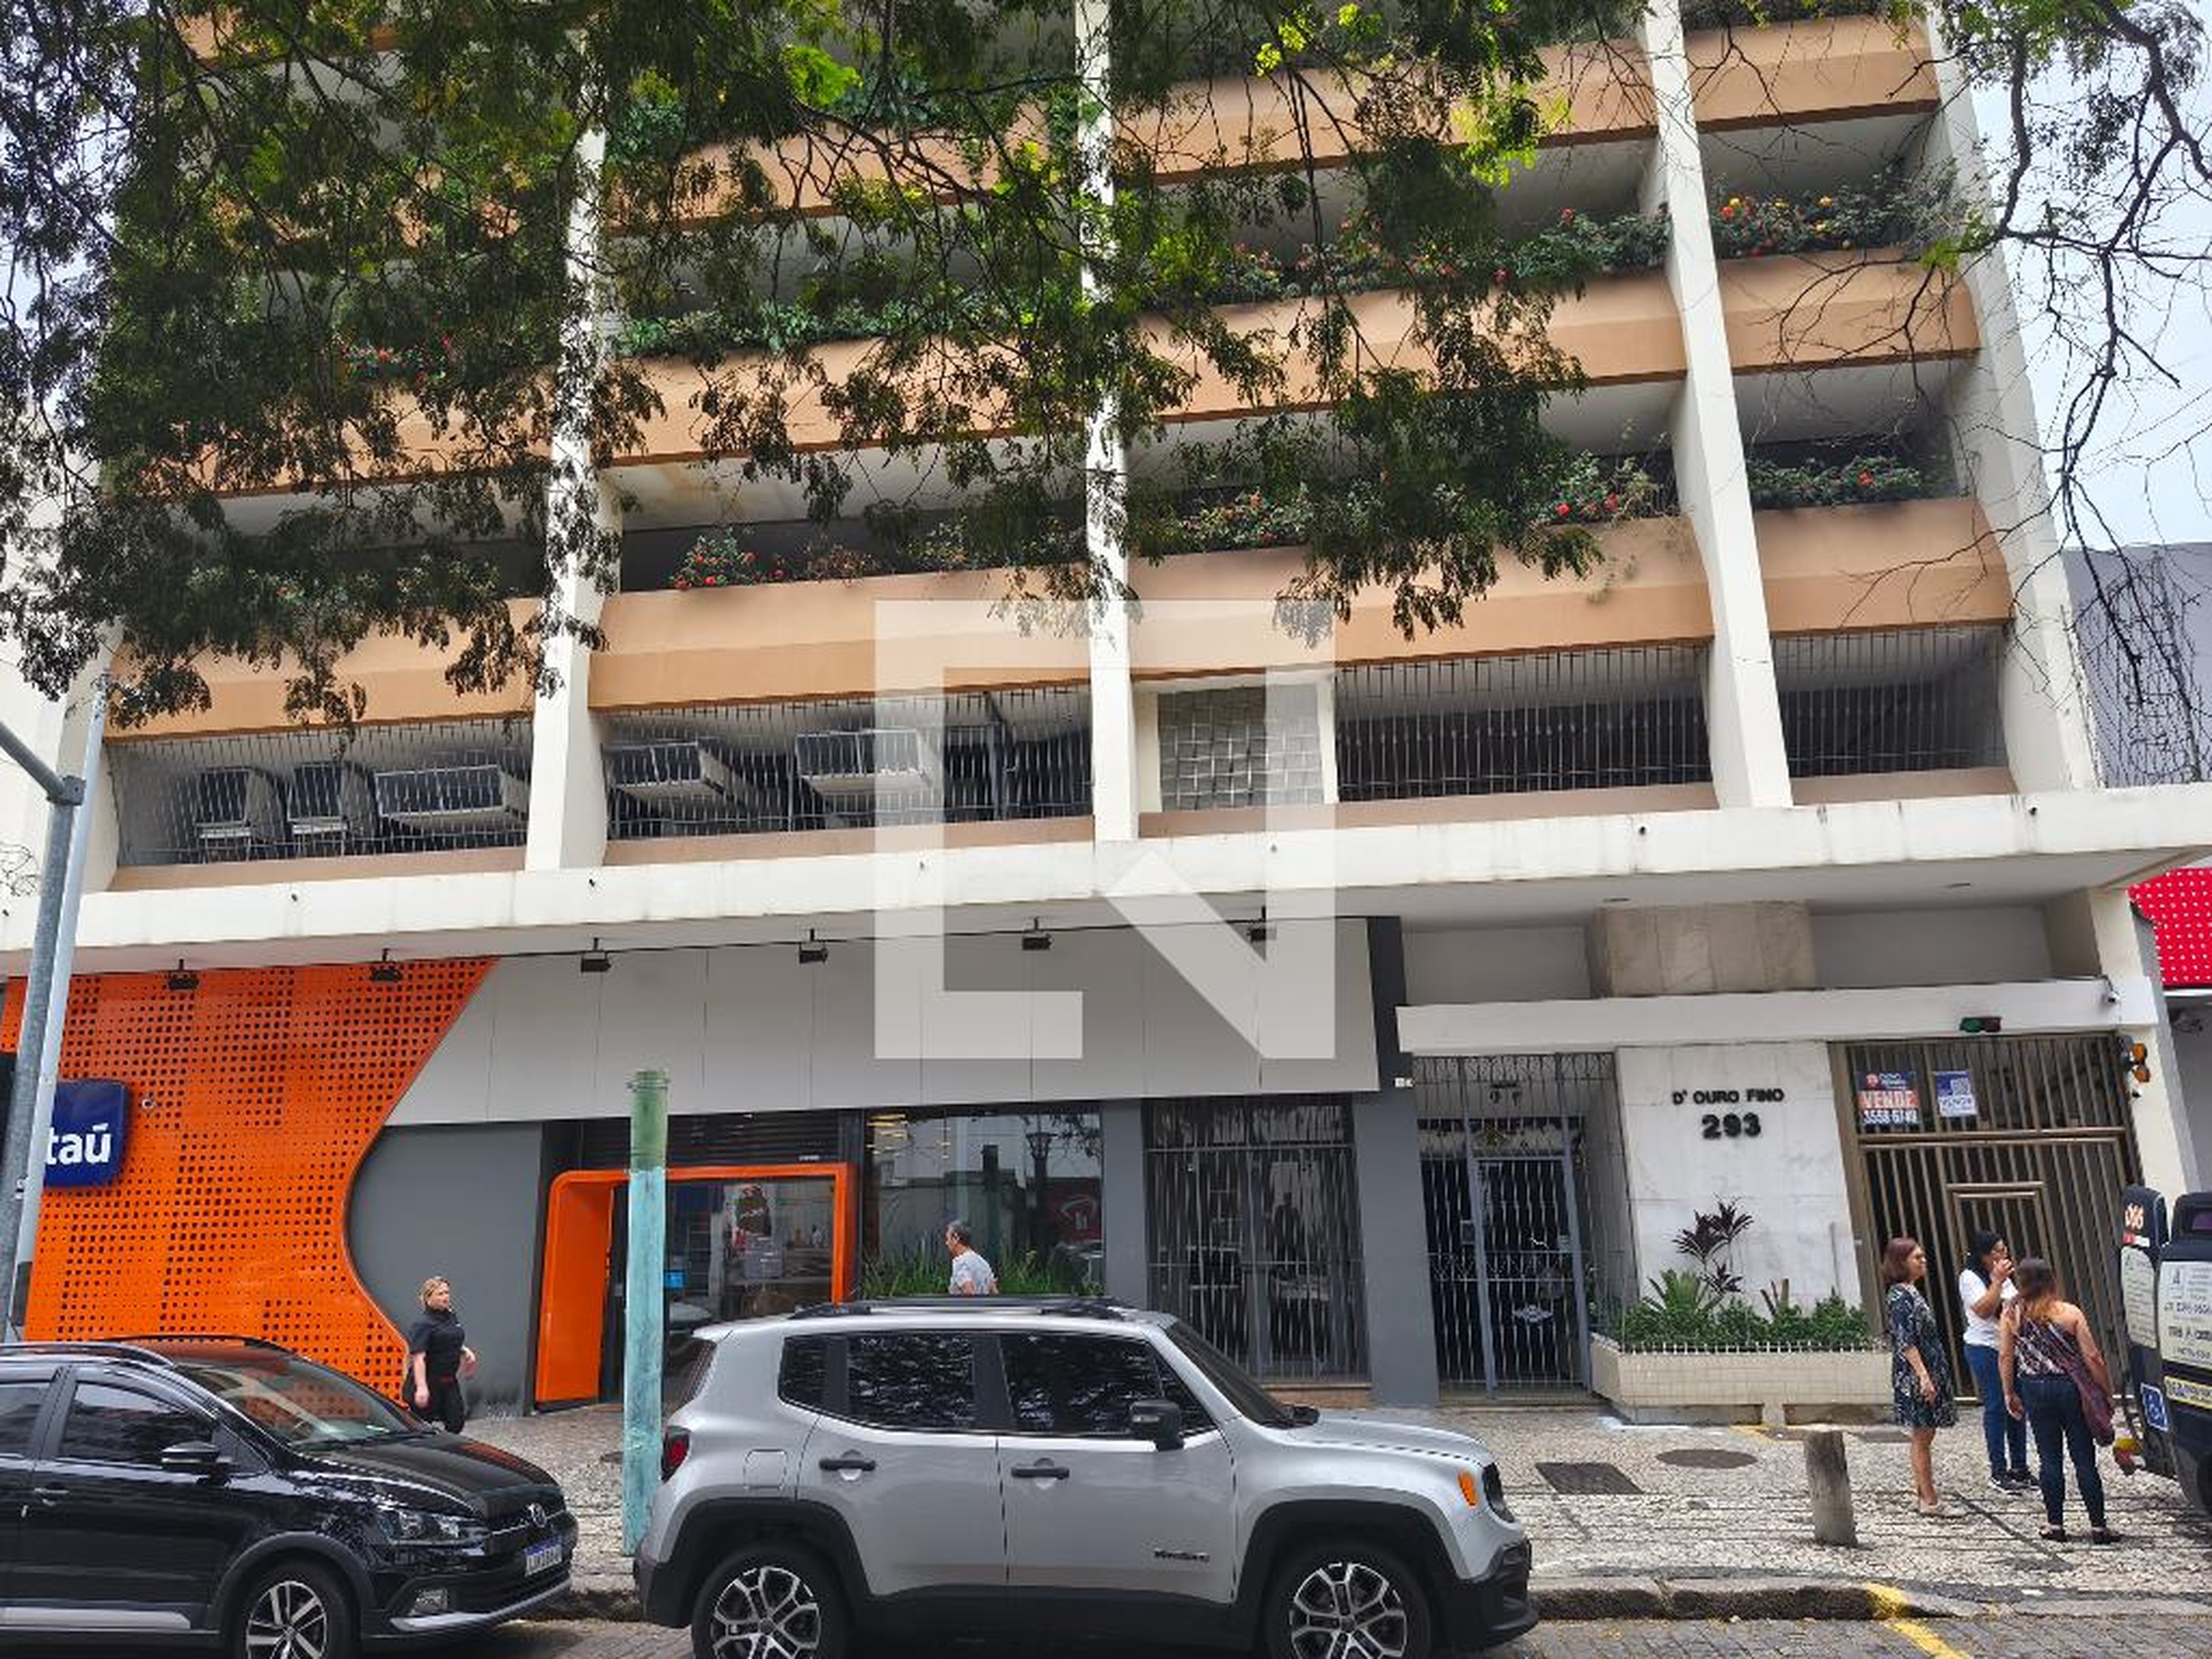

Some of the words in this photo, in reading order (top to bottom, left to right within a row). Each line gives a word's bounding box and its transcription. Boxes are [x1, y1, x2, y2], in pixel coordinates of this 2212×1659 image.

[1693, 1090, 1740, 1104] OURO
[1746, 1088, 1785, 1102] FINO
[1862, 1090, 1914, 1108] VENDE
[1701, 1112, 1762, 1139] 293
[44, 1123, 112, 1165] taú
